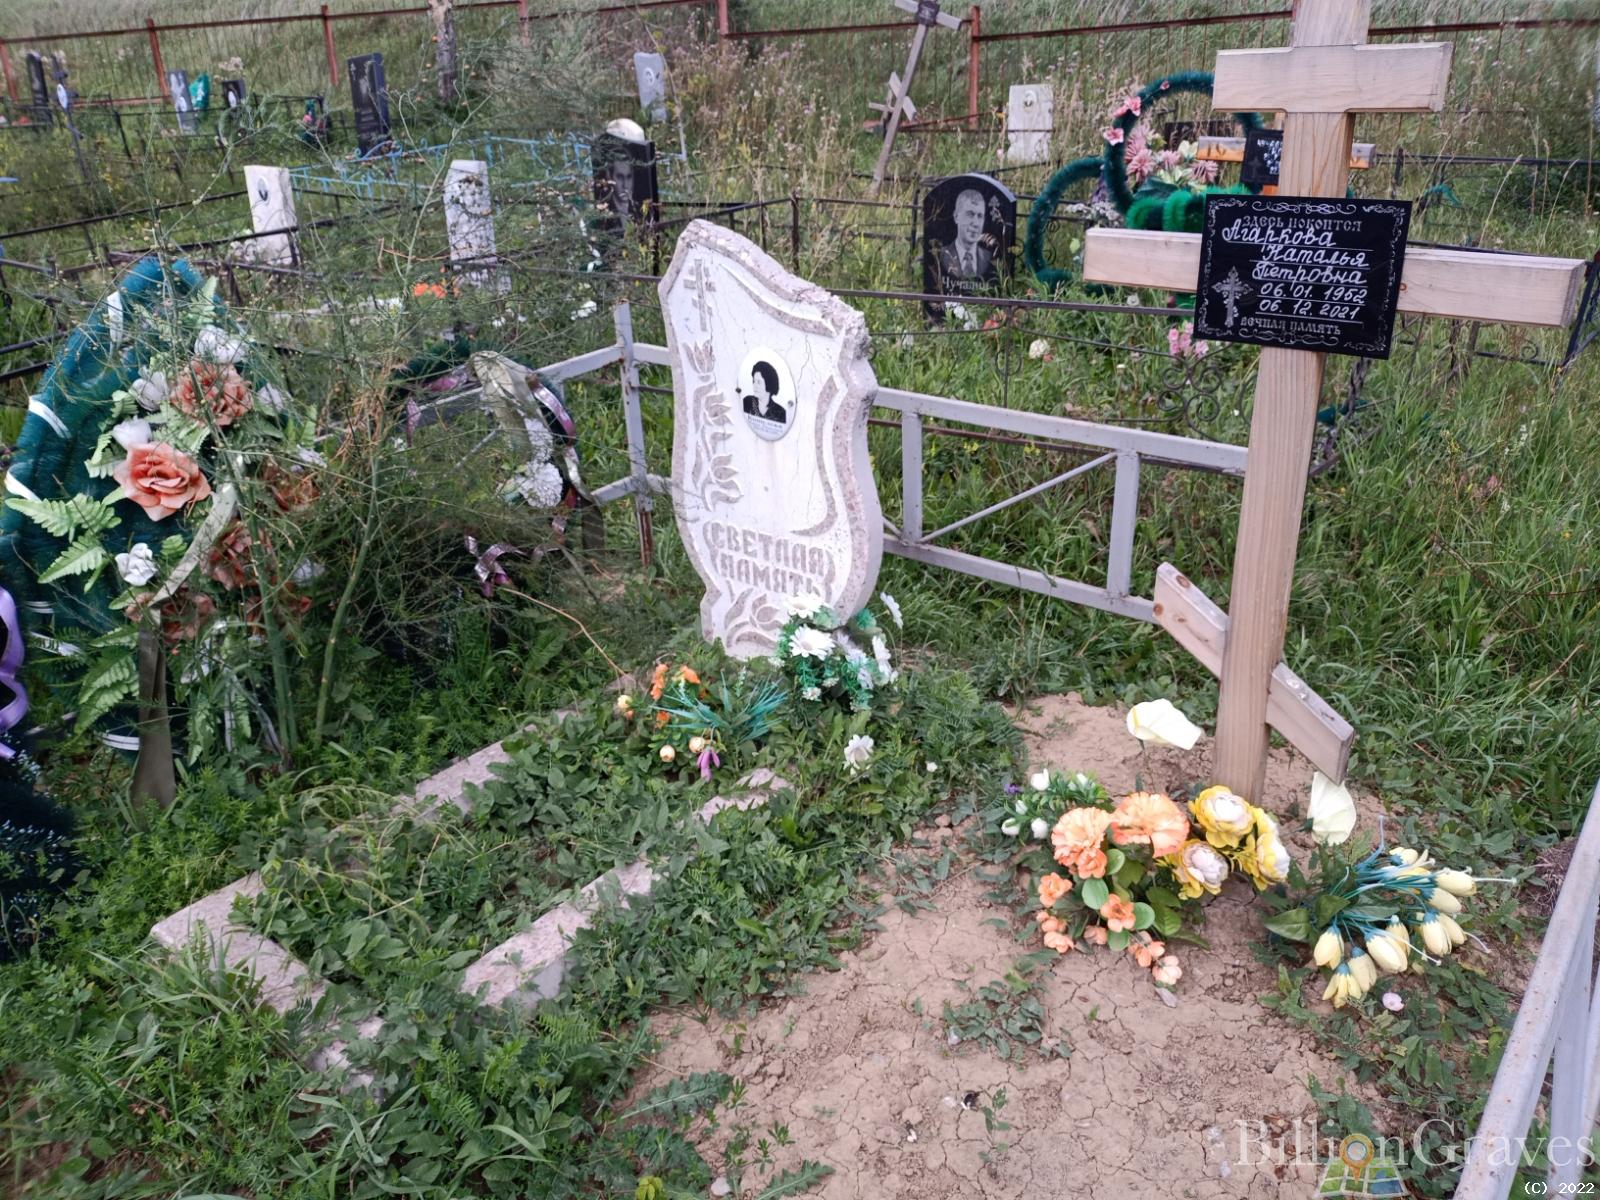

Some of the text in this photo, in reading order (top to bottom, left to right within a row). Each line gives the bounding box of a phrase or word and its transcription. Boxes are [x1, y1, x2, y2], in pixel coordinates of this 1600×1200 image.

[1222, 218, 1336, 253] Агаркова
[1242, 215, 1284, 228] ЗДЕСЬ
[1262, 244, 1369, 267] Наталья
[1252, 260, 1367, 291] Петровна
[1290, 321, 1341, 335] ПАМЯТЬ
[711, 522, 825, 577] СВЕТЛАЯ
[720, 552, 821, 597] ПАМЯТЬ
